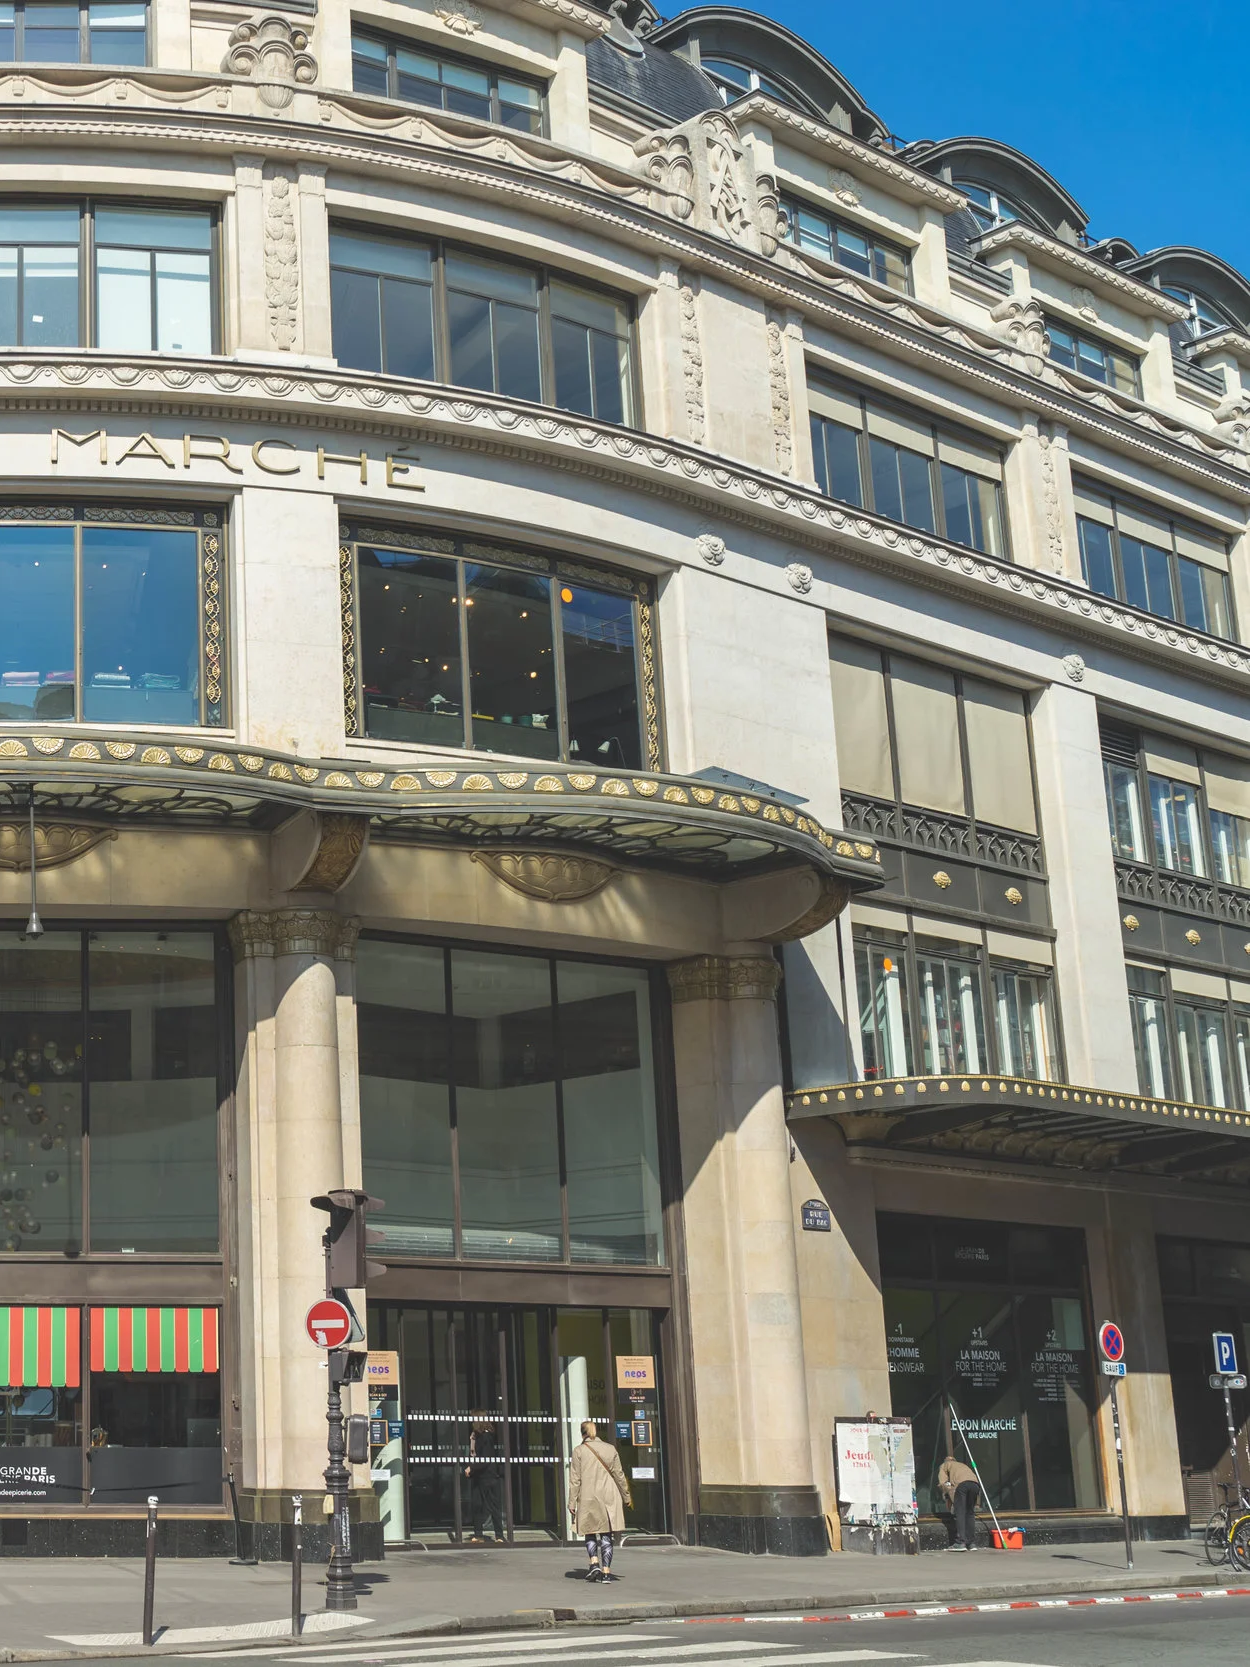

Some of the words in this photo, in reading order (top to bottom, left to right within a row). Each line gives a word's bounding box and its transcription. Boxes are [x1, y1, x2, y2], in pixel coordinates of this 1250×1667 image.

[50, 427, 427, 492] MARCHÉ
[809, 1210, 824, 1219] RUE
[960, 1349, 970, 1360] LA
[971, 1350, 1001, 1361] MAISON
[1035, 1351, 1045, 1362] LA
[1045, 1352, 1073, 1363] MAISON
[1221, 1341, 1231, 1366] P
[888, 1362, 925, 1373] ENSWEAR
[955, 1361, 971, 1372] FOR
[971, 1361, 985, 1372] THE
[985, 1361, 1007, 1372] HOME
[1031, 1362, 1045, 1373] FOR
[1045, 1363, 1059, 1373] THE
[1059, 1363, 1079, 1374] HOME
[1105, 1363, 1118, 1373] SAUF
[959, 1419, 979, 1431] BON
[980, 1416, 1017, 1431] MARCHÉ
[0, 1466, 47, 1476] GRANDE
[23, 1475, 56, 1484] PARIS
